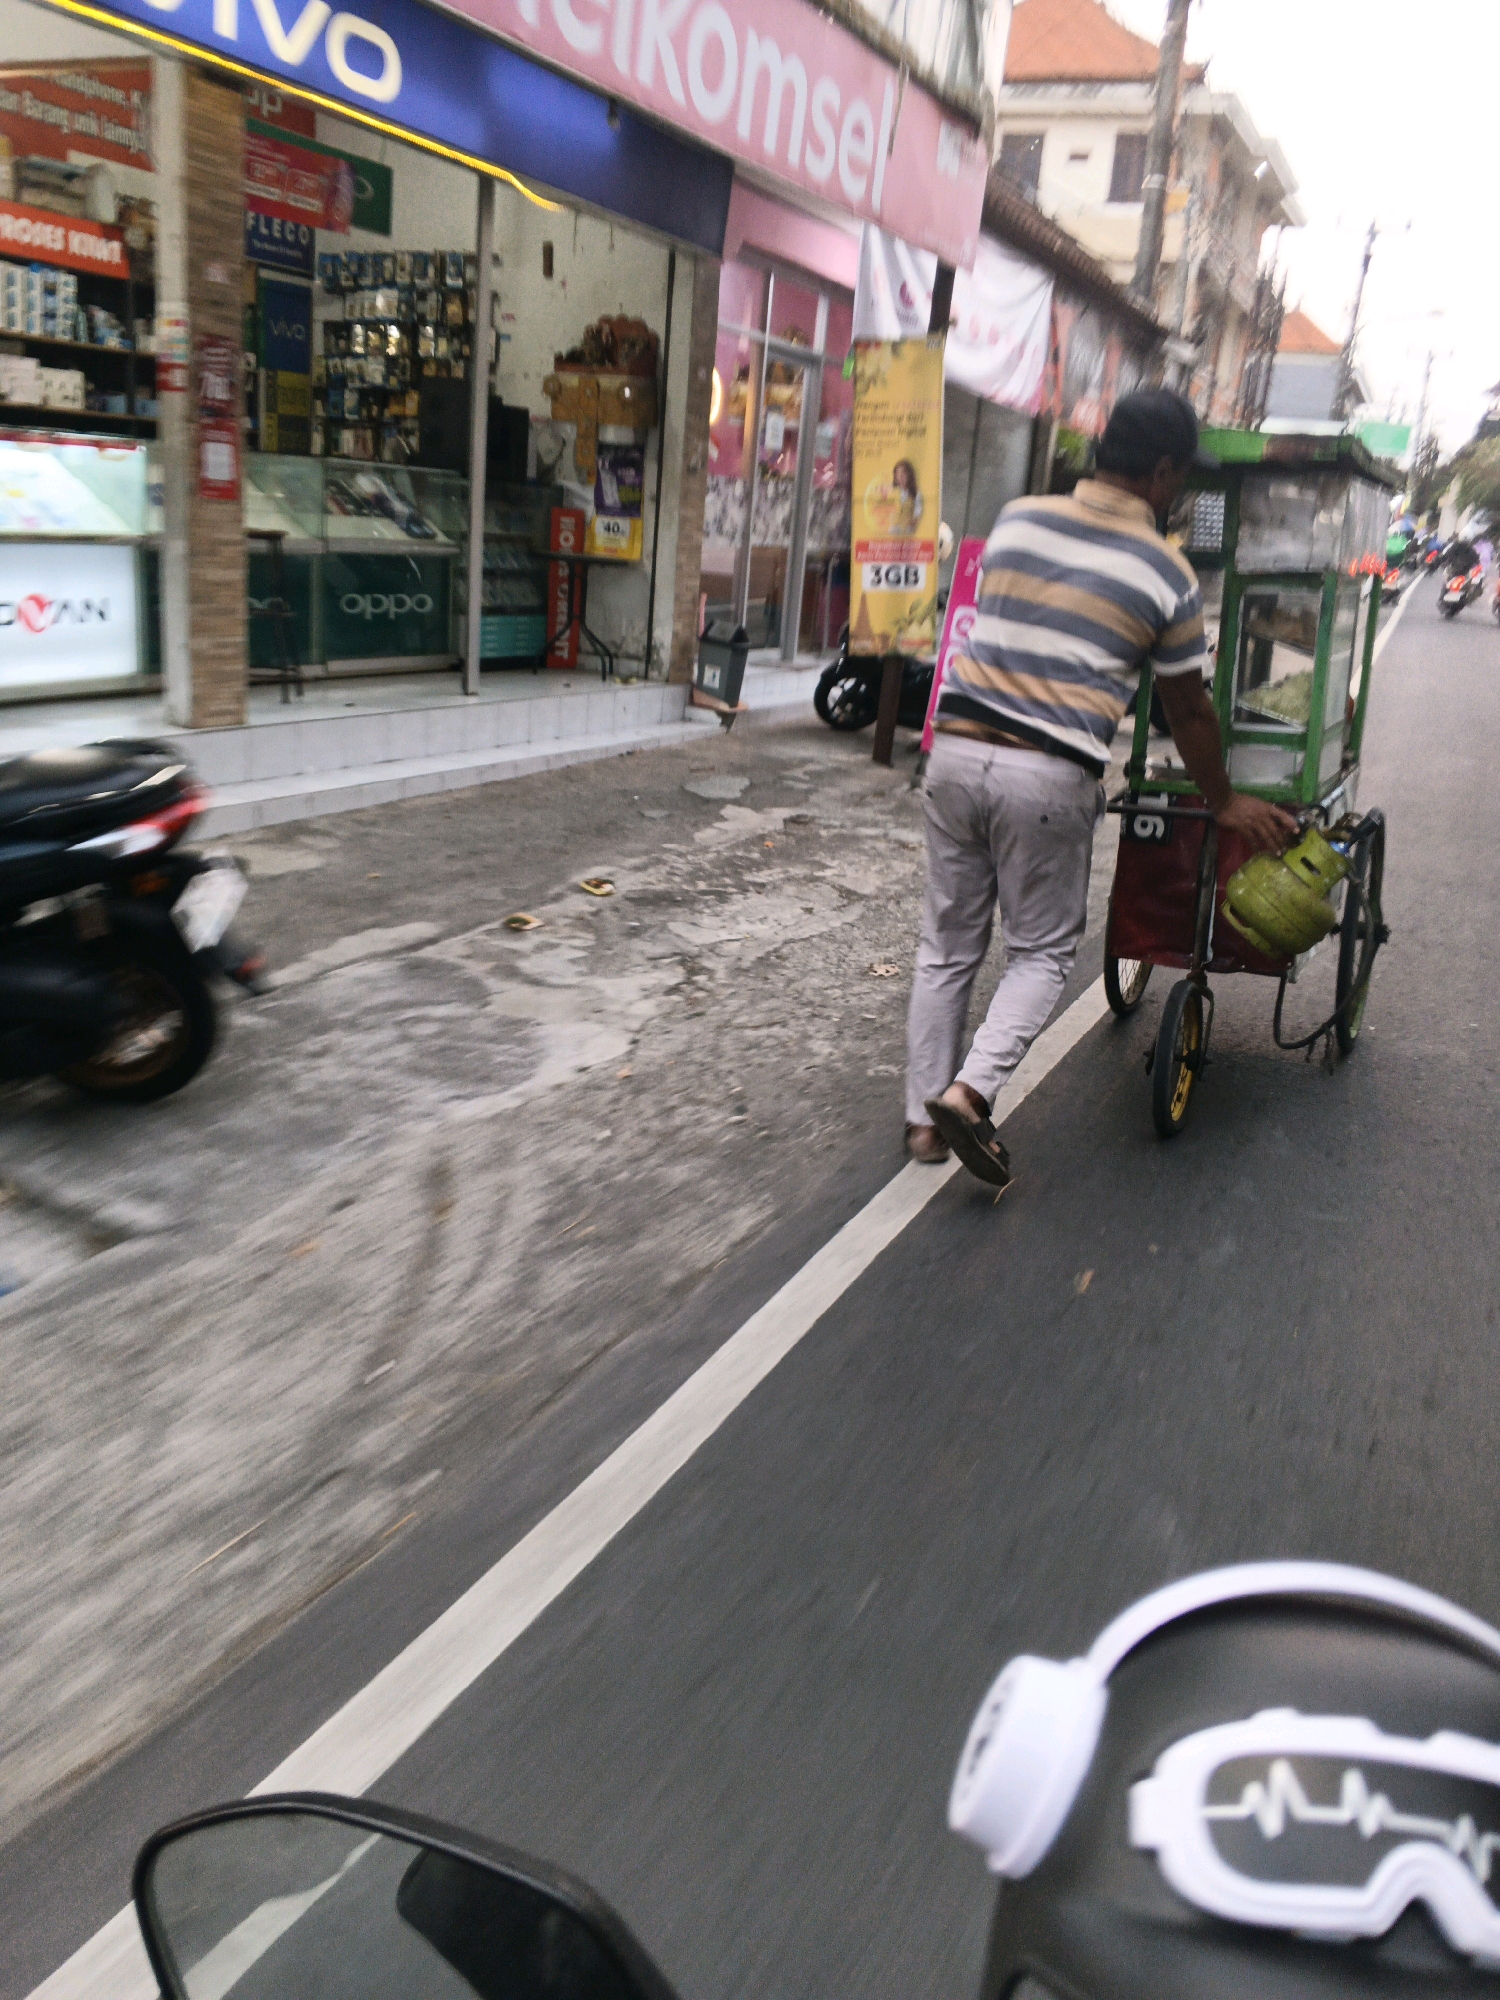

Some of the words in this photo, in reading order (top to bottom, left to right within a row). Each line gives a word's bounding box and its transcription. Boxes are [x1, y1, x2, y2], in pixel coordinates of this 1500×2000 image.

[141, 0, 402, 103] vo
[517, 0, 894, 214] elkomsel
[557, 516, 577, 578] HOE
[869, 563, 920, 589] 3GB
[339, 593, 434, 620] oppo
